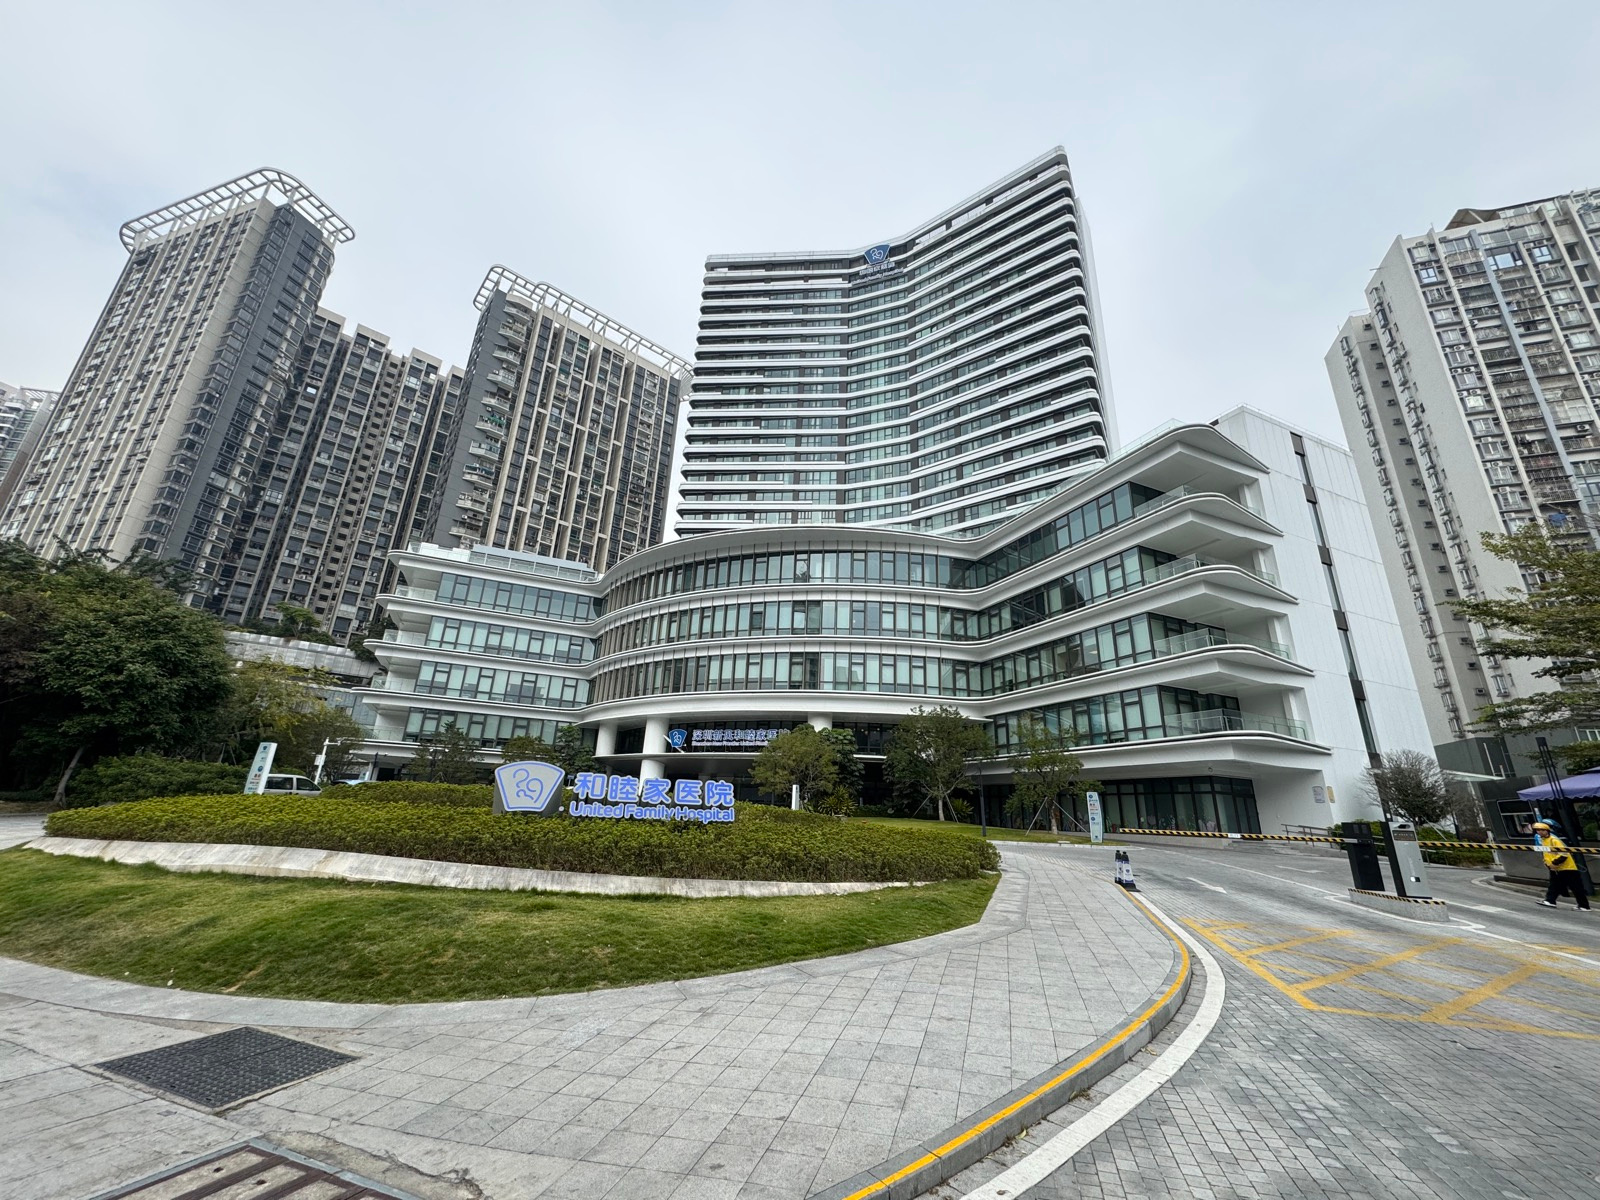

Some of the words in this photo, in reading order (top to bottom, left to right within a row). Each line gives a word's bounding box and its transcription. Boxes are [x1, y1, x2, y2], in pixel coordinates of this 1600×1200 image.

[574, 772, 734, 806] 和睦家医院
[569, 801, 625, 818] United
[624, 803, 676, 821] Family
[675, 806, 735, 824] Hospital
